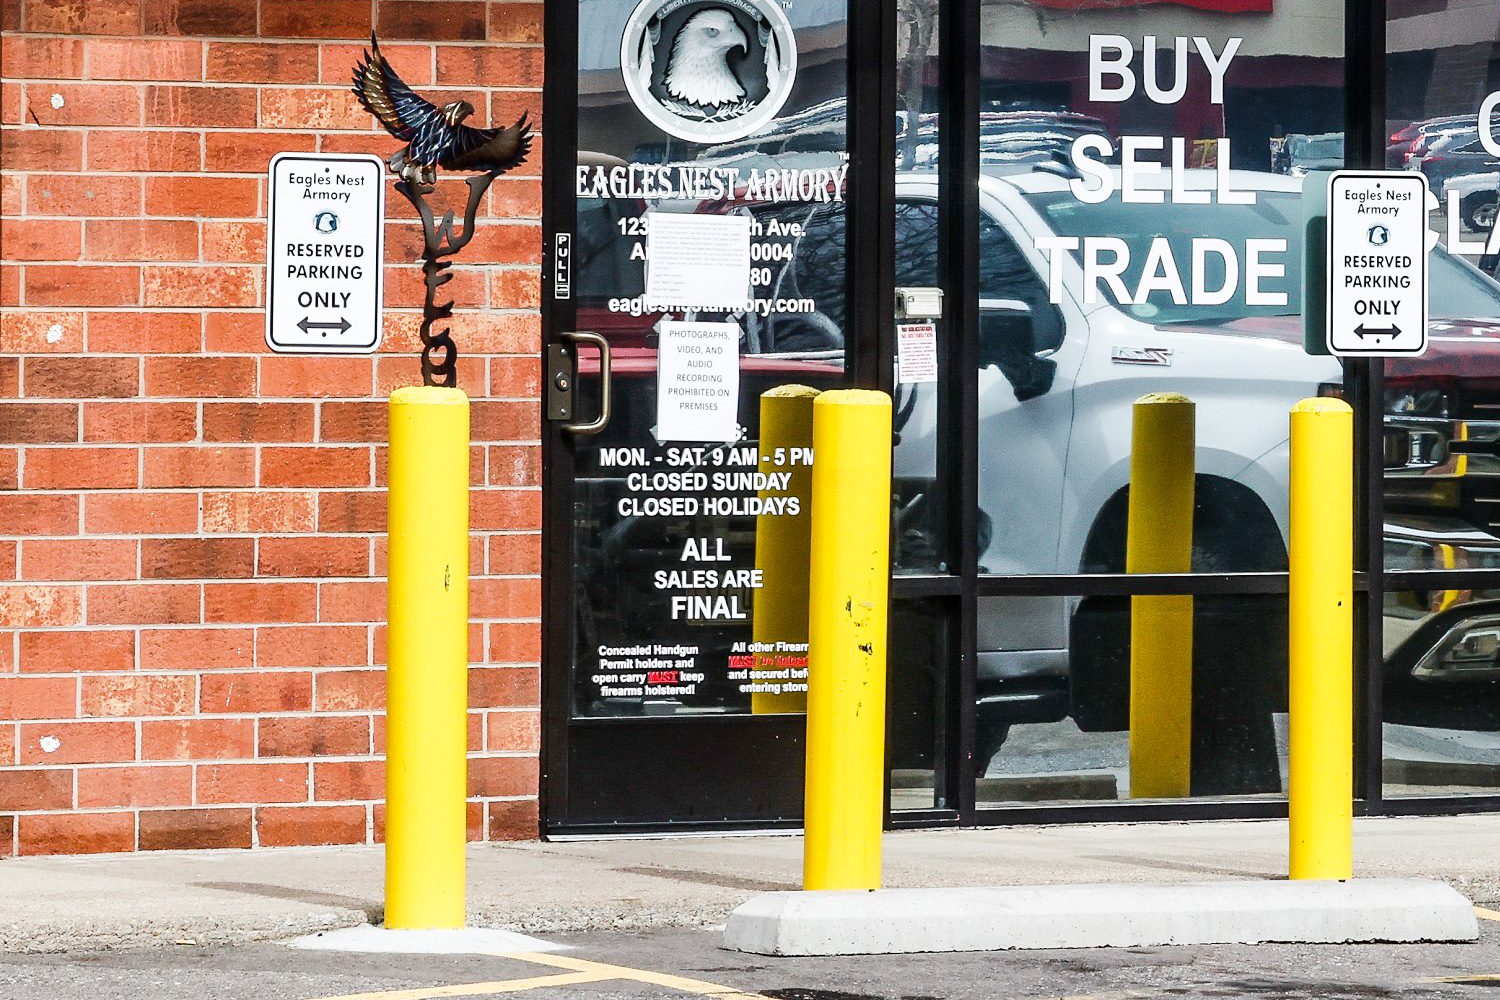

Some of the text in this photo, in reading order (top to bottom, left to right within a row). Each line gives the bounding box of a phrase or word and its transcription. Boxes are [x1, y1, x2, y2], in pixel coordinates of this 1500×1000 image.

[1088, 33, 1243, 104] BUY
[1068, 133, 1257, 206] SELL
[289, 173, 364, 187] Eagles Nest
[576, 163, 849, 204] EAGLES NEST ARMORY
[303, 188, 351, 203] Armory
[1345, 189, 1412, 203] Eagles Nest
[1357, 203, 1399, 217] Armory
[767, 219, 806, 237] Ave.
[287, 243, 364, 258] RESERVED
[750, 243, 793, 261] 0004
[558, 236, 568, 282] PULL
[1344, 255, 1412, 268] RESERVED
[287, 265, 363, 280] PARKING
[1033, 235, 1288, 306] TRADE
[1345, 275, 1411, 288] PARKING
[297, 291, 351, 308] ONLY
[1354, 299, 1401, 315] ONLY
[669, 330, 730, 340] PHOTOGRAPHS,
[677, 346, 703, 354] VIDEO,
[687, 360, 713, 368] AUDIO
[676, 374, 722, 382] RECORDING
[668, 387, 715, 396] PROHIBITED
[679, 402, 718, 411] PREMISES
[600, 448, 650, 466] MON.
[666, 447, 707, 466] SAT.
[712, 448, 724, 466] 9
[726, 447, 757, 466] AM
[774, 447, 786, 466] 5
[627, 472, 792, 491] CLOSED SUNDAY
[618, 497, 800, 516] CLOSED HOLIDAYS
[680, 537, 732, 561] ALL
[654, 569, 763, 589] SALES ARE
[671, 595, 747, 620] FINAL
[598, 644, 699, 657] Concealed Handgun
[731, 641, 746, 653] All
[747, 641, 775, 652] other
[599, 657, 694, 669] Permit holders and
[591, 670, 705, 685] open carry MUST keep
[727, 669, 748, 680] and
[749, 668, 789, 679] secured
[600, 684, 695, 696] firearms holstered!
[739, 682, 808, 694] entering store
